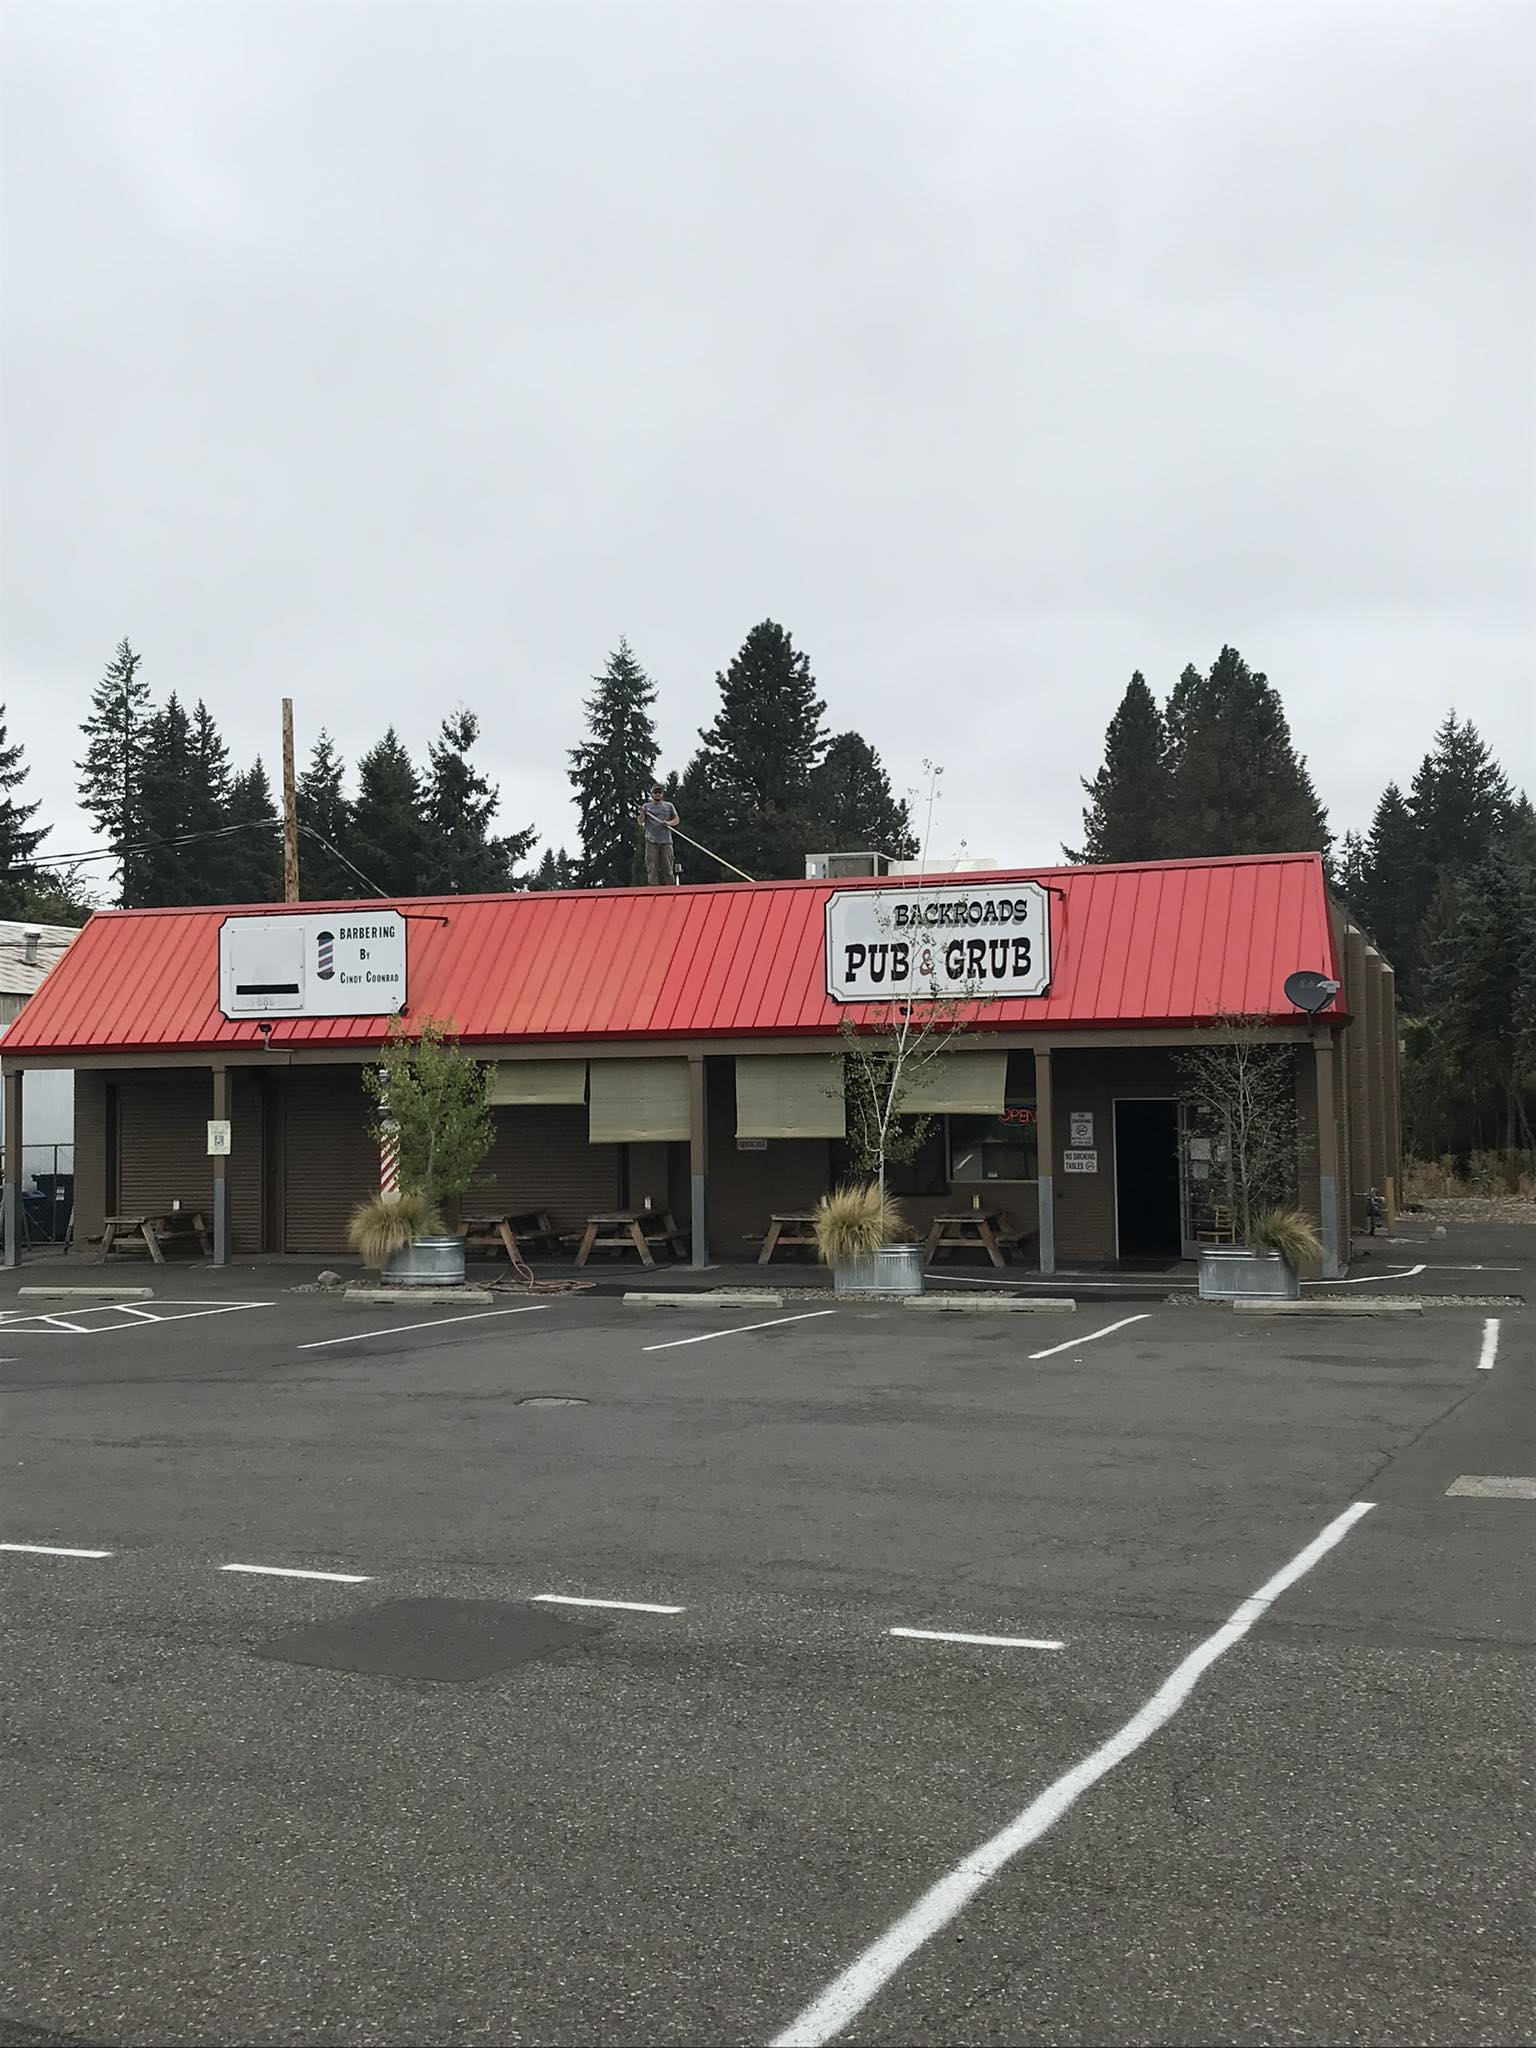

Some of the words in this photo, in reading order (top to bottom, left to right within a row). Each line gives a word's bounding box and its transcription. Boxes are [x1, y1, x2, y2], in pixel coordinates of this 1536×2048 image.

[894, 899, 1028, 928] BACKROADS
[340, 926, 395, 939] BARBERING
[845, 942, 910, 983] PUB
[919, 948, 934, 976] &
[945, 937, 1031, 980] GRUB
[340, 972, 362, 984] CINDY
